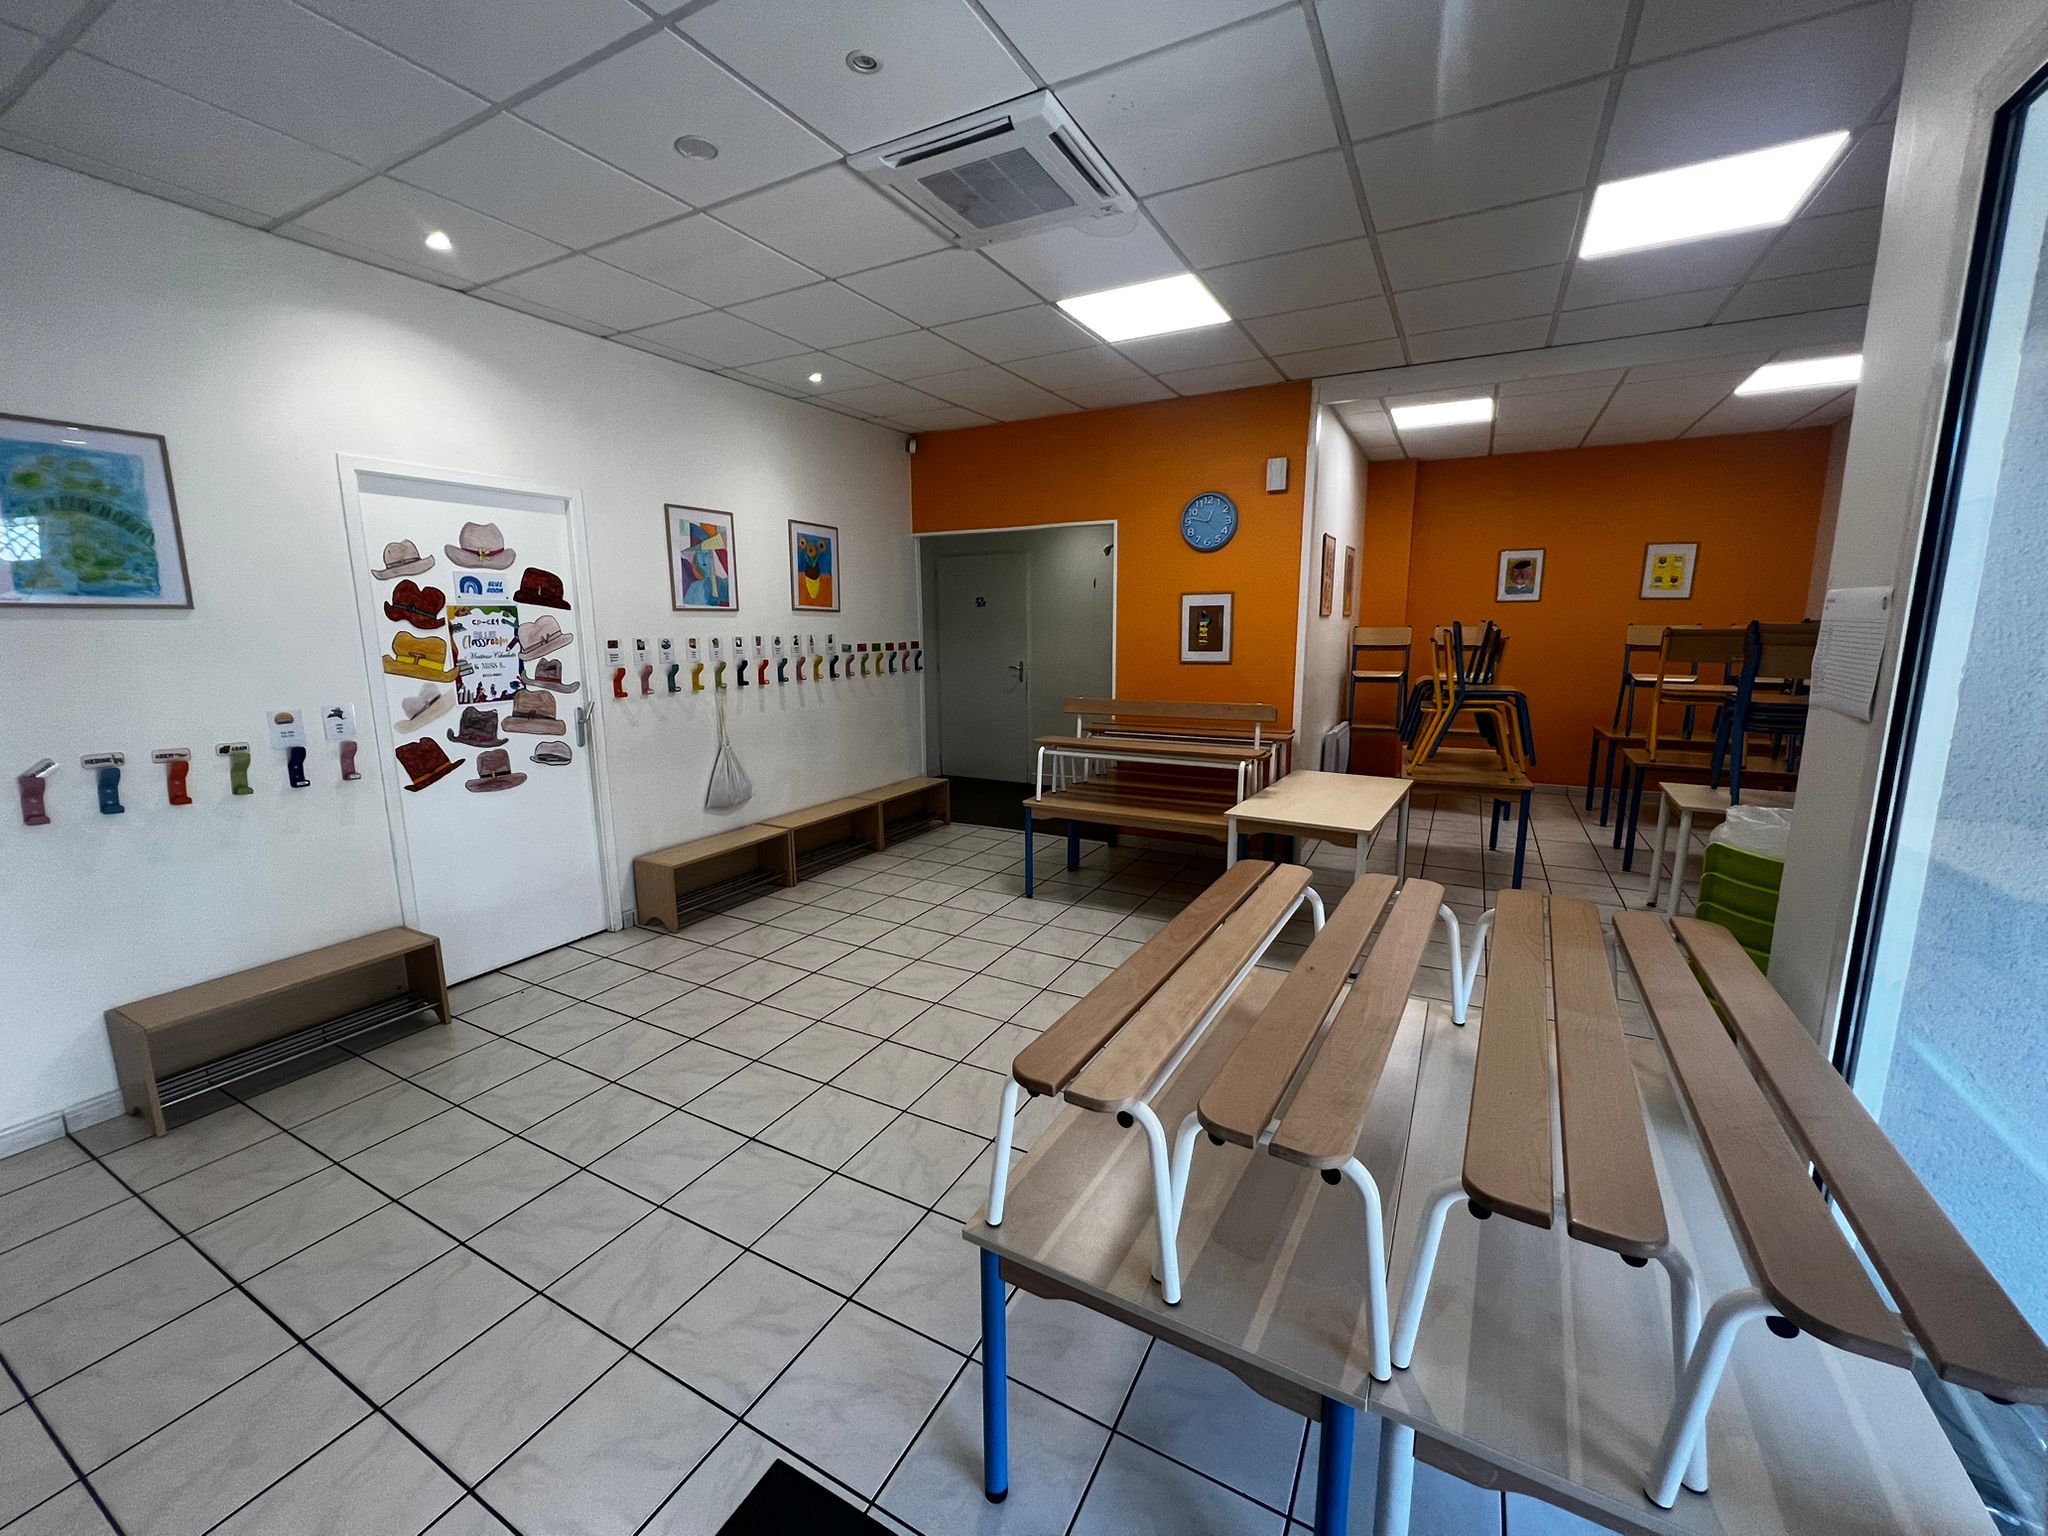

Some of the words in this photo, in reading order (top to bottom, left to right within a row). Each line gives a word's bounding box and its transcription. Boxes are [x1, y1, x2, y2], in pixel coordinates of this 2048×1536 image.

[1203, 496, 1213, 504] 12
[1222, 505, 1229, 513] 2
[1185, 518, 1192, 527] 9
[1225, 516, 1232, 524] 3
[1187, 528, 1195, 537] 8
[1221, 526, 1228, 534] 4
[1195, 536, 1201, 544] 7
[1203, 538, 1211, 546] 6
[1215, 534, 1222, 543] 5
[462, 634, 509, 649] Classroom
